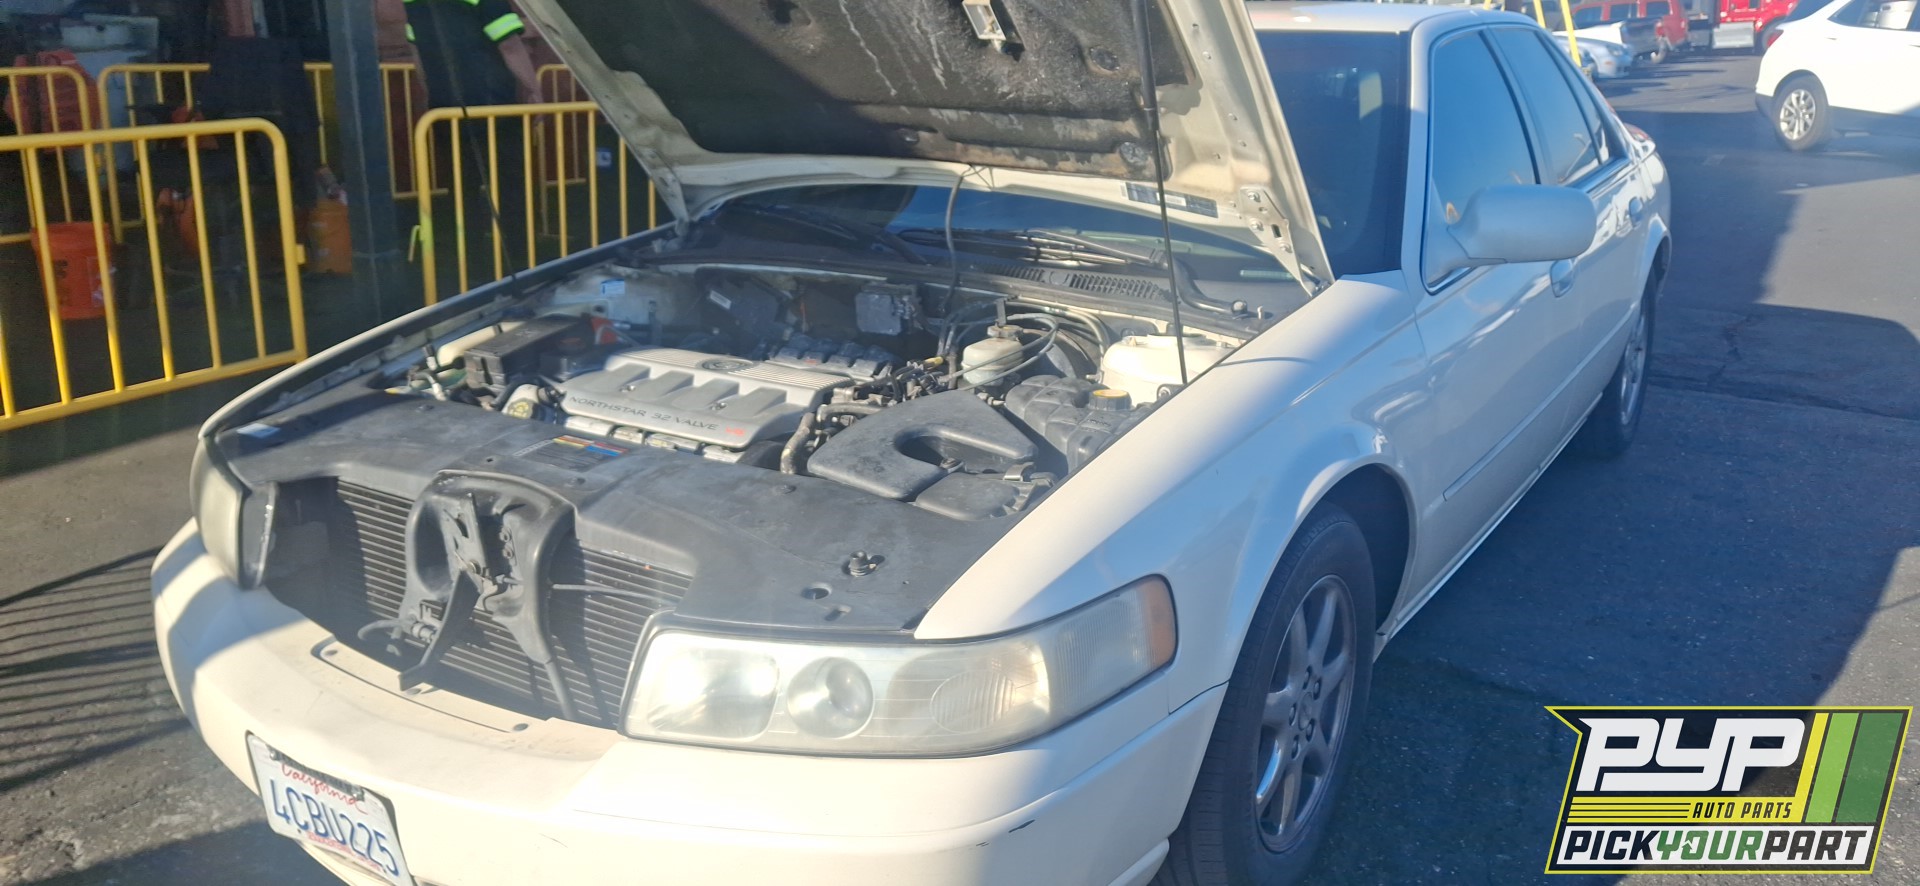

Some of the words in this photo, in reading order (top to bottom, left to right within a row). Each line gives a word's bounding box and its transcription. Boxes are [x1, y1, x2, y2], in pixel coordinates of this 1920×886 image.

[570, 396, 647, 417] NORTHSTAR
[651, 412, 671, 422] 32
[675, 416, 719, 431] VALVE
[269, 778, 400, 877] 4CBU225
